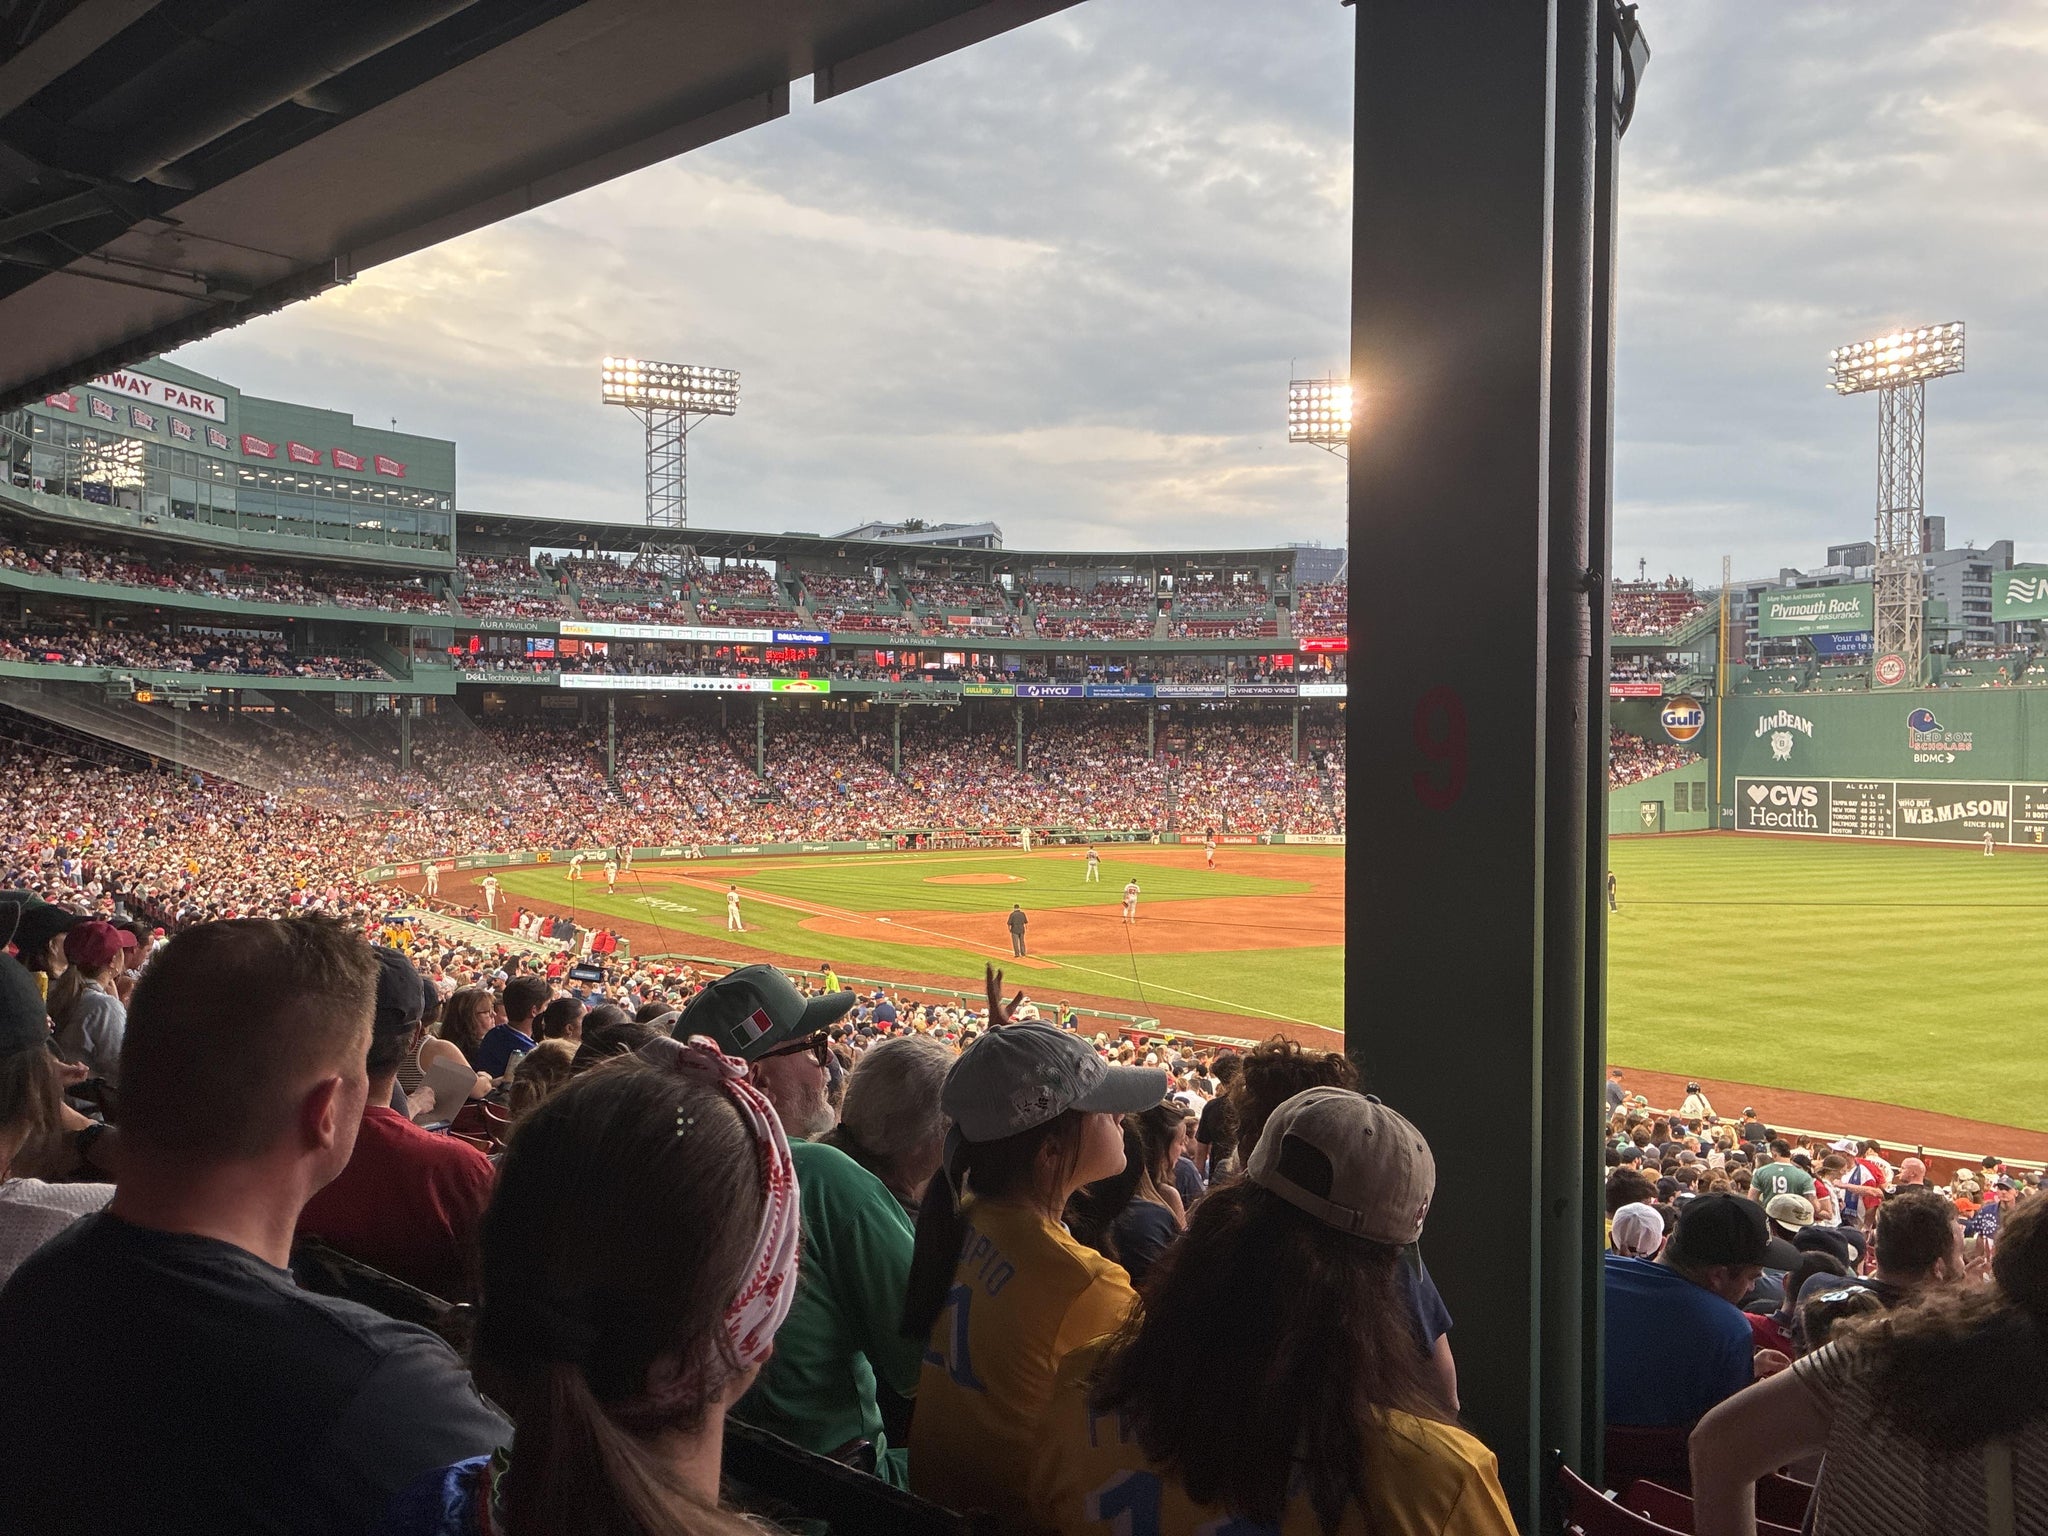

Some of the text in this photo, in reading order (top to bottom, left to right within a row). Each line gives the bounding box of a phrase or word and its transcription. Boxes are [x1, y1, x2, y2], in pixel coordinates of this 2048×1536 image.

[97, 373, 215, 414] NWAY PARK
[1770, 597, 1860, 618] Plymouth Rock
[1832, 634, 1853, 642] Your
[466, 672, 487, 681] DELL
[487, 673, 531, 683] Technologies
[1663, 711, 1701, 725] Gulf
[1914, 732, 1973, 742] RED SOX
[1412, 684, 1469, 812] 9
[1914, 742, 1972, 751] SCHOLARS
[1913, 754, 1944, 762] BIDMC
[1769, 785, 1818, 807] CVS
[1750, 806, 1818, 828] Health
[1772, 1176, 1788, 1194] 19
